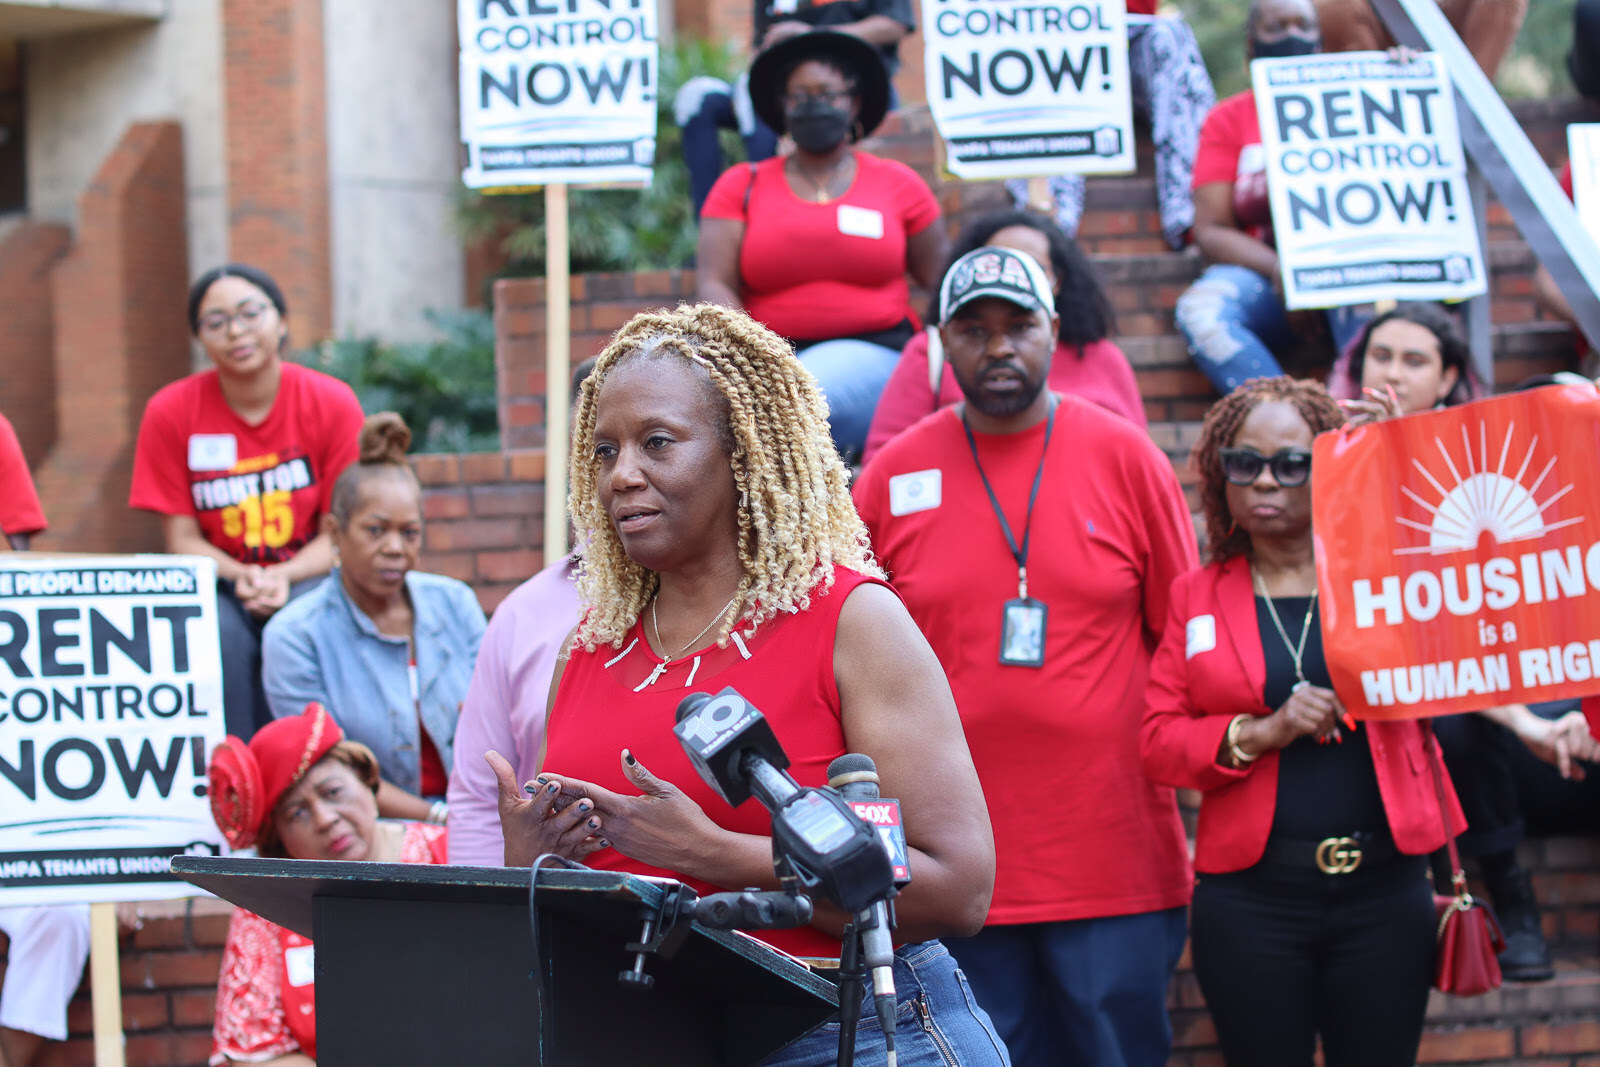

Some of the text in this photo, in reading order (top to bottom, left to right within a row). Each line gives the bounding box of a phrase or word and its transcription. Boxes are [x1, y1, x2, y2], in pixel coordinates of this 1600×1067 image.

[478, 17, 656, 51] CONTROL
[937, 6, 1111, 36] CONTROL
[480, 58, 652, 108] NOW!
[941, 45, 1110, 98] NOW!
[1274, 88, 1439, 142] RENT
[1281, 143, 1452, 175] CONTROL
[1287, 180, 1456, 231] NOW!
[953, 253, 1032, 296] USA
[192, 472, 261, 511] FIGHT
[262, 457, 312, 497] FOR
[221, 490, 294, 548] $15
[15, 571, 96, 596] PEOPLE
[97, 570, 195, 593] DEMAND:
[1478, 619, 1518, 647] is a
[1361, 653, 1511, 706] HUMAN
[0, 683, 208, 723] ONTROL
[682, 695, 746, 744] 10
[854, 804, 893, 824] FOX
[43, 857, 118, 876] TENANTS
